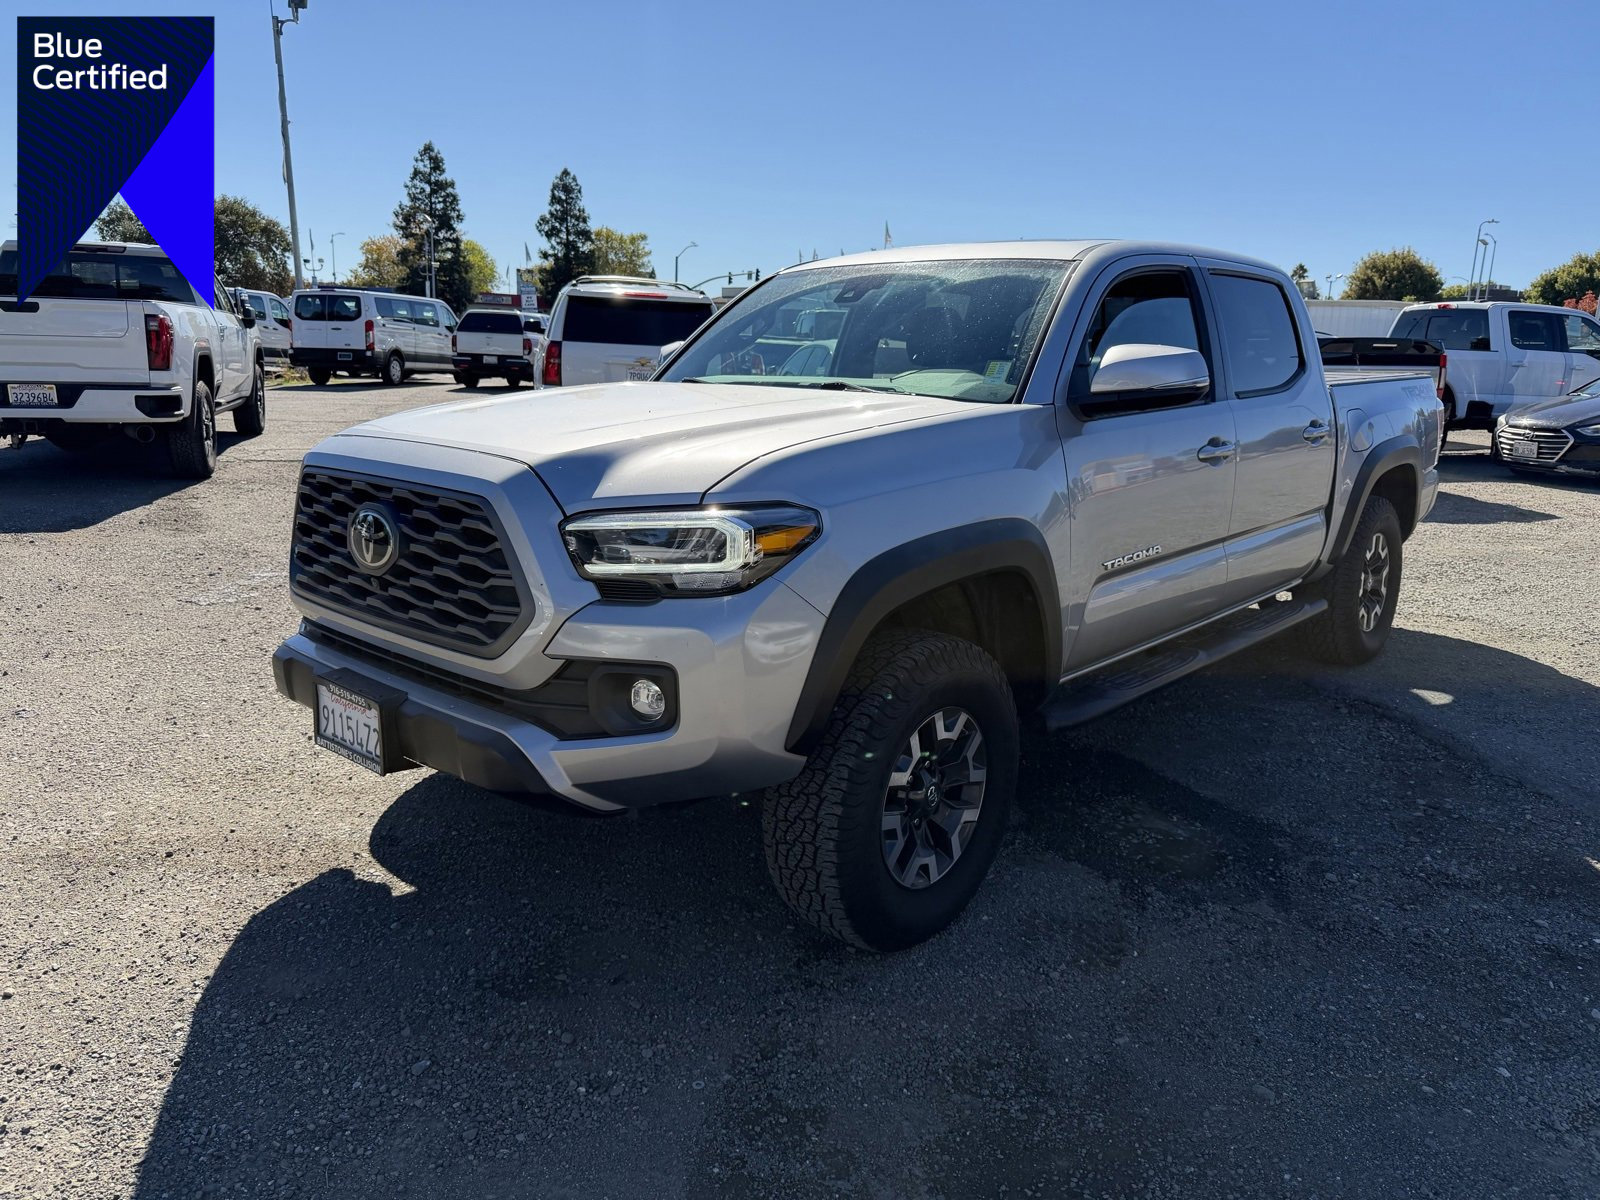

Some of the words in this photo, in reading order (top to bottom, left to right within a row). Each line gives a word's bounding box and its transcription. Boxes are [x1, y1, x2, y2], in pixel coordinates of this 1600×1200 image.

[12, 392, 54, 402] 32396B4
[1102, 545, 1162, 570] TACOMA
[329, 684, 366, 706] 916-519-4755
[316, 736, 353, 760] BATTISTONE'S
[353, 753, 380, 773] COLLISION
